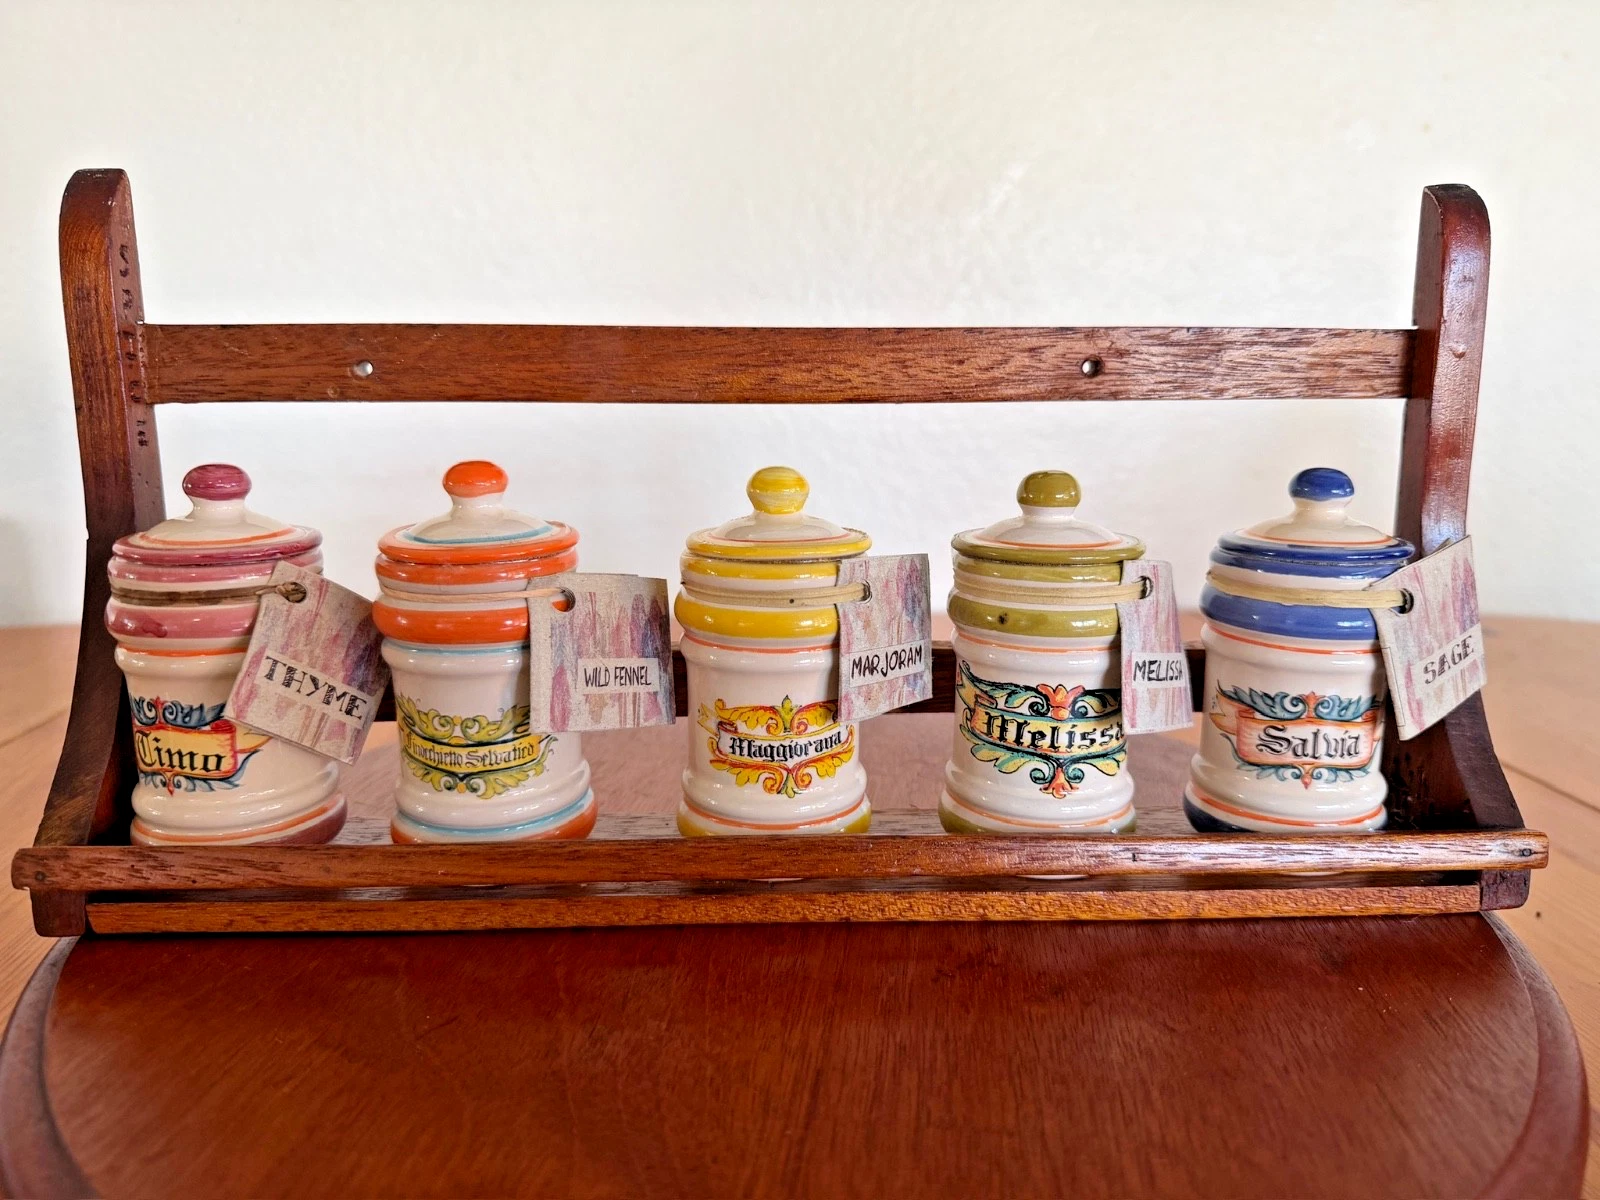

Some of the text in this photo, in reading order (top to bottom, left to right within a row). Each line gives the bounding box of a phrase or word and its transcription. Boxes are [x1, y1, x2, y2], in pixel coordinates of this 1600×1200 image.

[583, 665, 652, 688] WILD FENNEL
[851, 644, 924, 679] MARJORAM
[1133, 659, 1184, 681] MELISSA
[1424, 635, 1474, 685] SAGE
[263, 655, 368, 721] THYME
[729, 730, 843, 763] Maggiorana
[984, 711, 1125, 751] Melissa
[1256, 724, 1361, 760] Salvia
